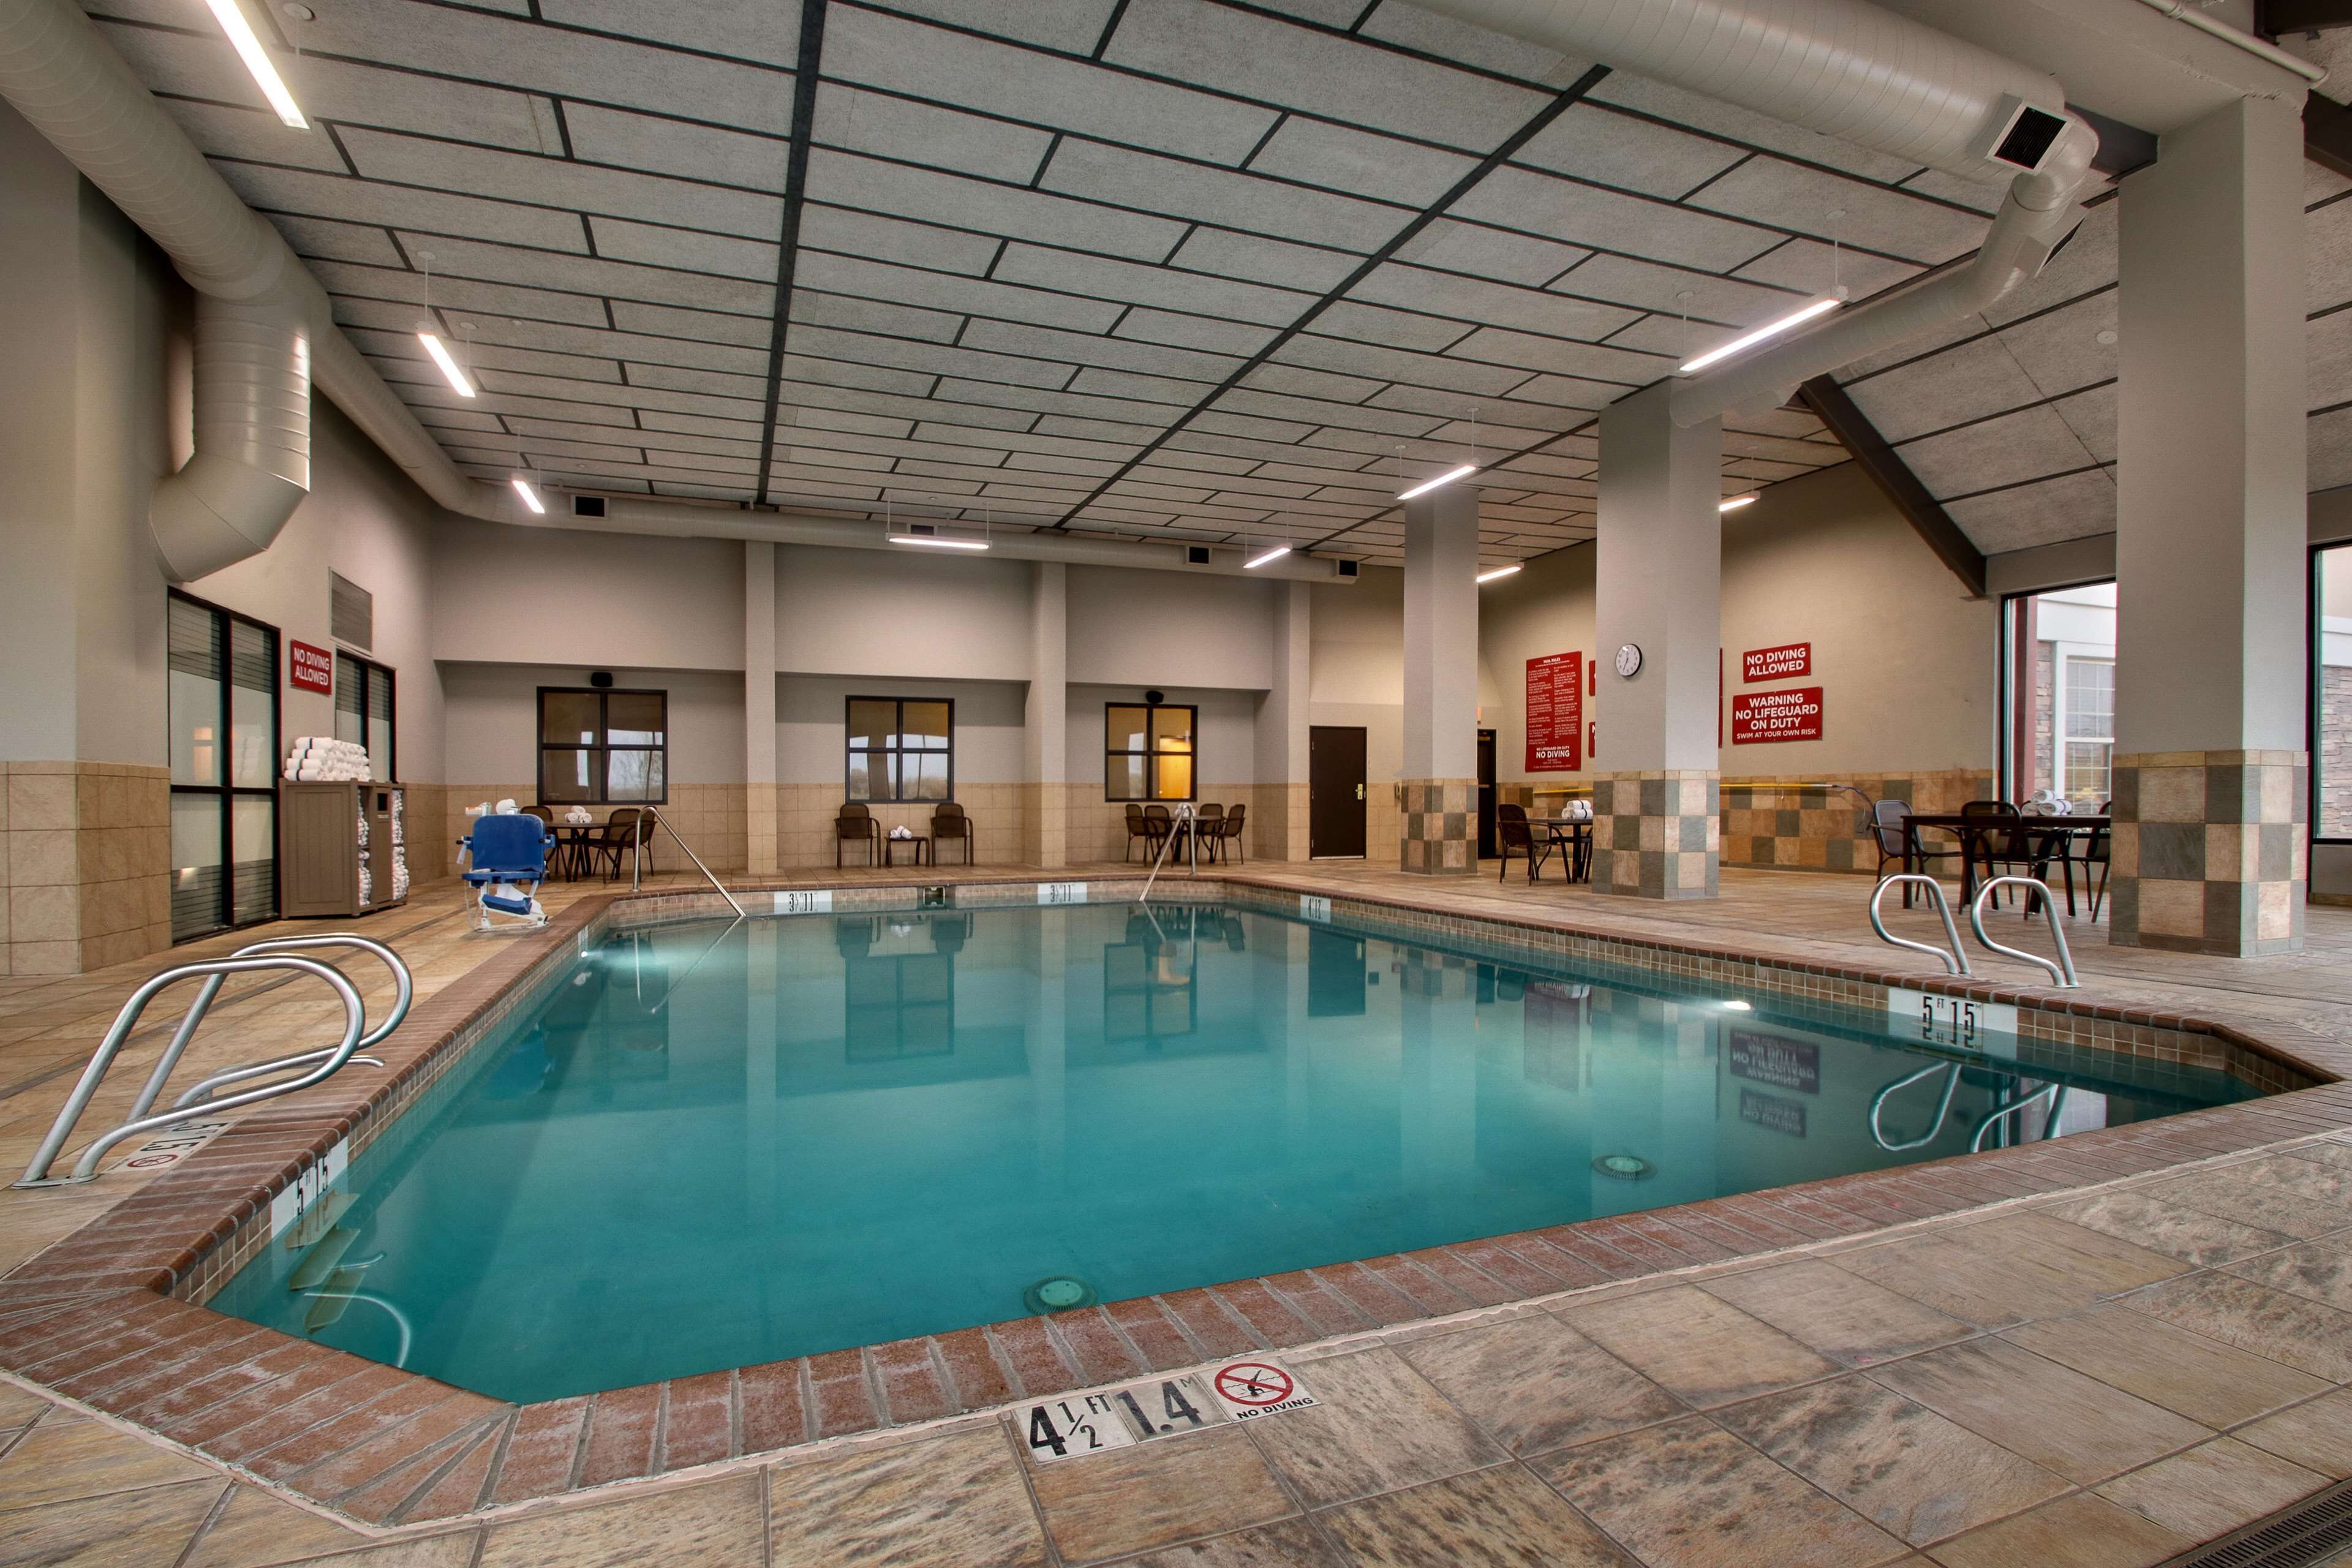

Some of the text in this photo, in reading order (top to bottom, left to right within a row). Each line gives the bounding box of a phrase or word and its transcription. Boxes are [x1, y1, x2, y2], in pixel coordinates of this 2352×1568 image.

[294, 647, 330, 671] NO DIVING
[1747, 647, 1806, 666] NO DIVING
[295, 665, 329, 685] ALLOWED
[1748, 660, 1804, 676] ALLOWED
[1749, 693, 1804, 708] WARNING
[1735, 704, 1819, 720] NO LIFEGUARD
[1751, 717, 1801, 730] ON DUTY
[1937, 998, 1945, 1009] FT
[1084, 1393, 1113, 1415] FT
[1113, 1381, 1205, 1436] 1.4
[1180, 1378, 1199, 1389] M
[1236, 1396, 1314, 1420] NO DIVING
